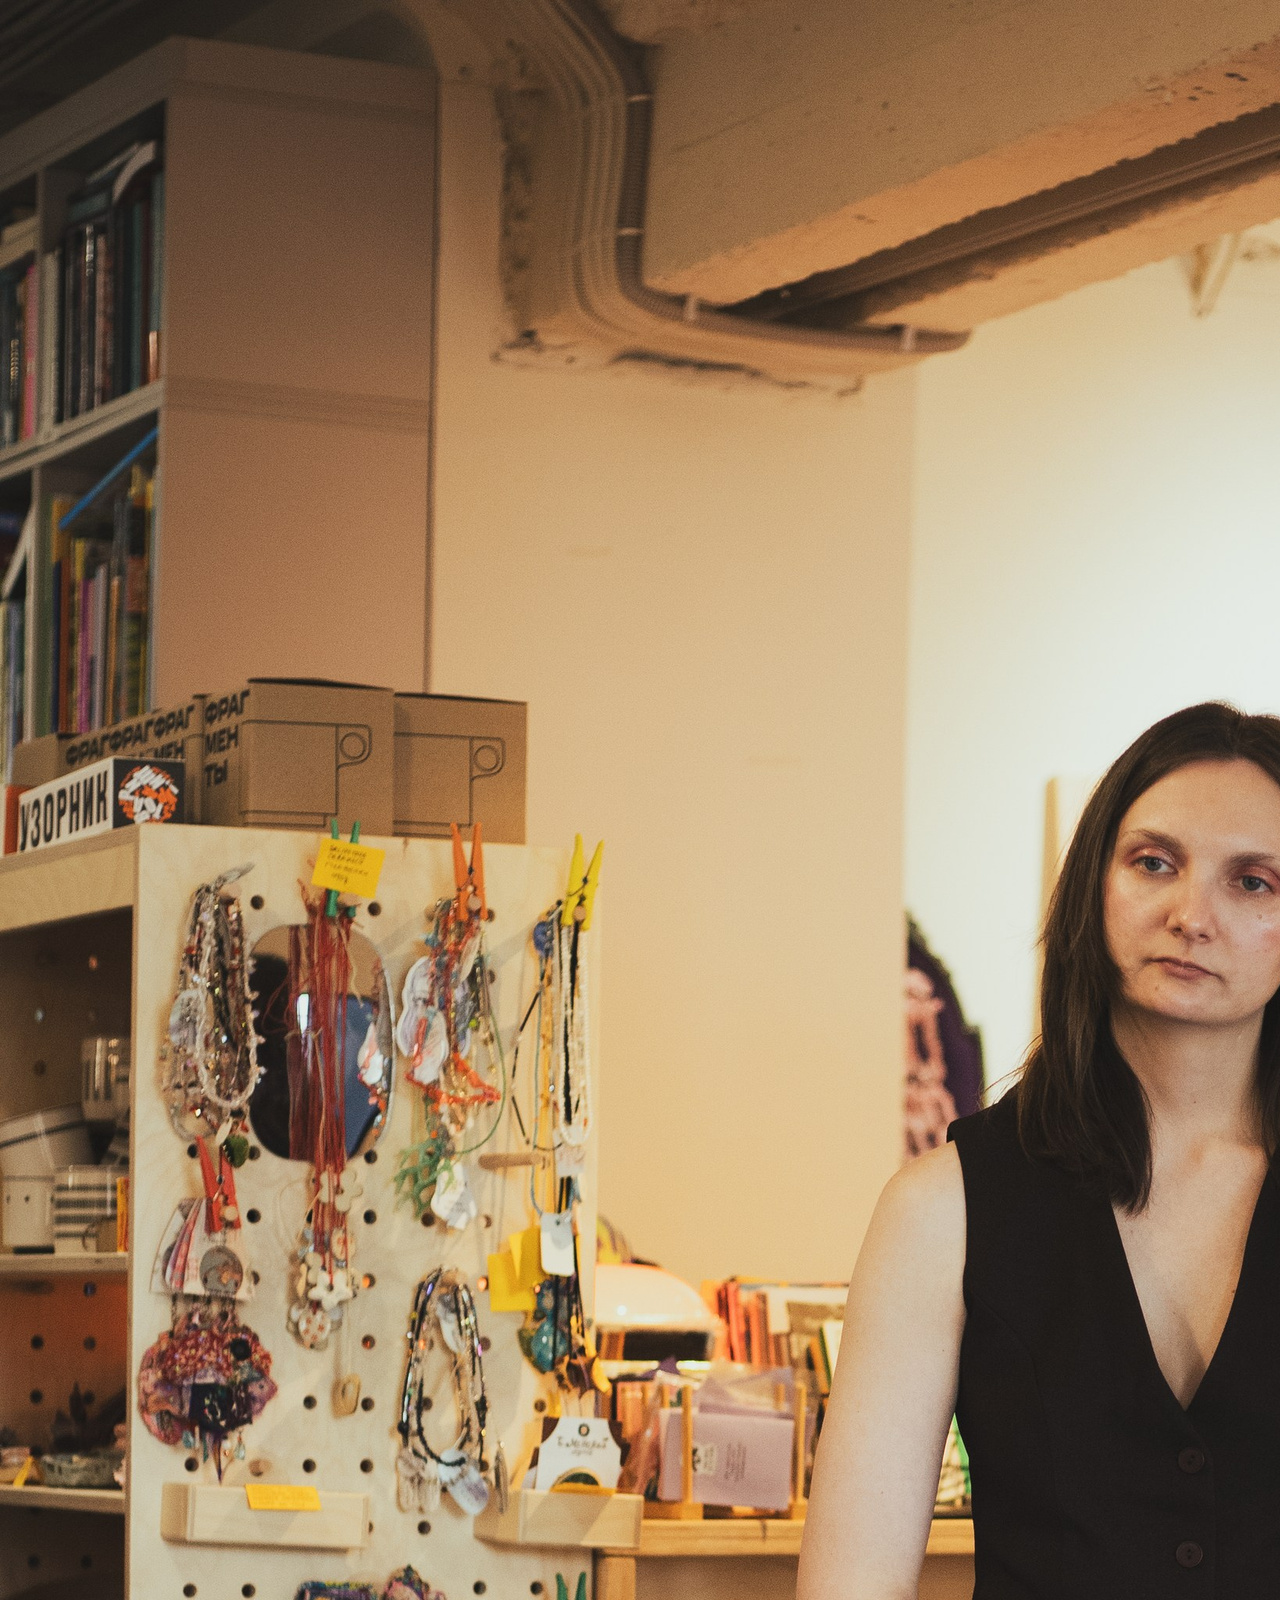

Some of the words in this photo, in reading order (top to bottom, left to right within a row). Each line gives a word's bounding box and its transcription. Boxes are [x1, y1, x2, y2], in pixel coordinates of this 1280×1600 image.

[205, 689, 249, 724] ФРАГ
[204, 724, 238, 757] МЕН
[205, 759, 228, 787] ТЫ
[20, 769, 109, 851] УЗОРНИК
